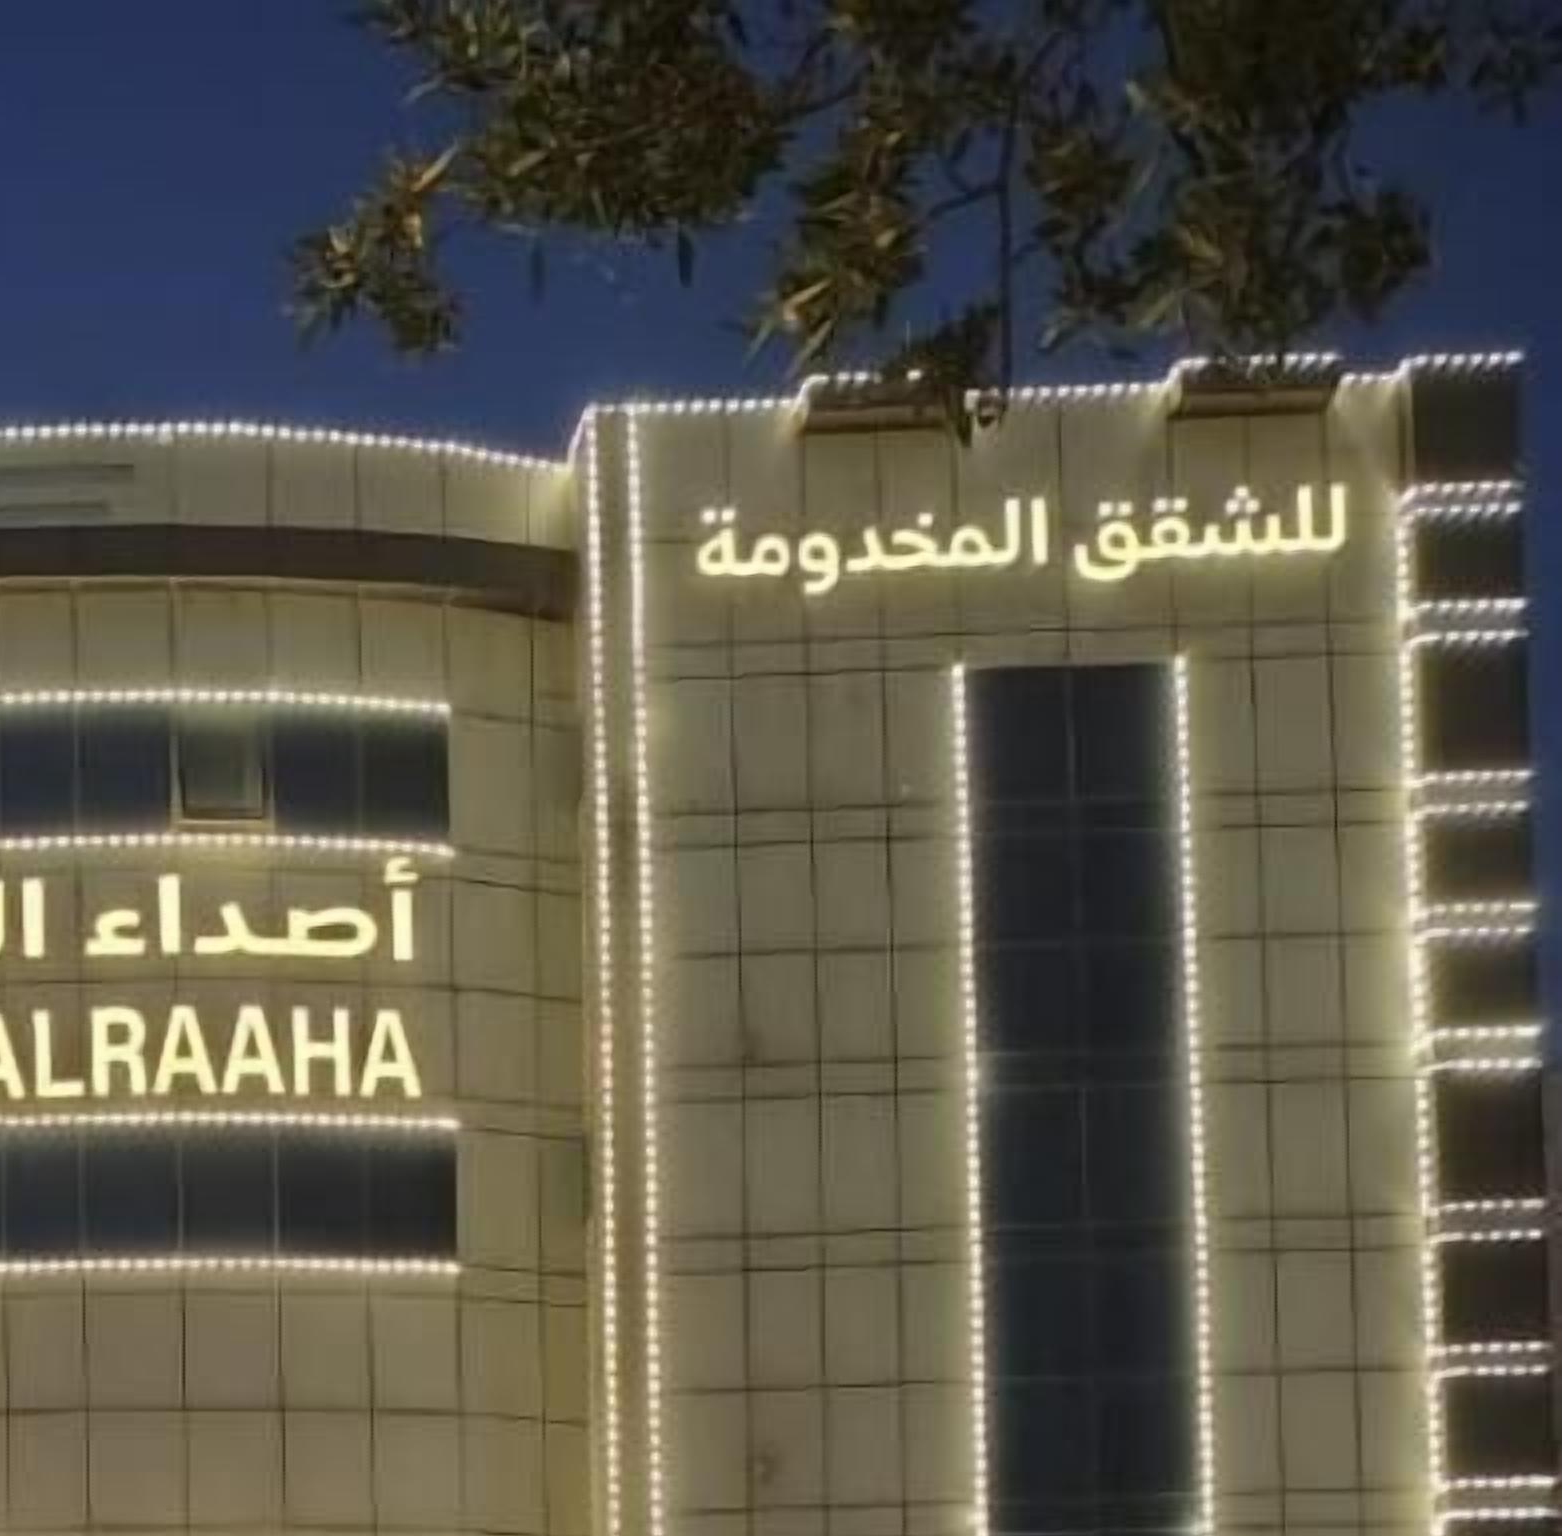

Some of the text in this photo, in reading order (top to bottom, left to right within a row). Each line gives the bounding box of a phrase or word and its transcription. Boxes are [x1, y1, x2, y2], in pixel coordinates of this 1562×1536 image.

[696, 483, 1347, 595] للشقق المخدومة
[84, 856, 420, 962] أصداء
